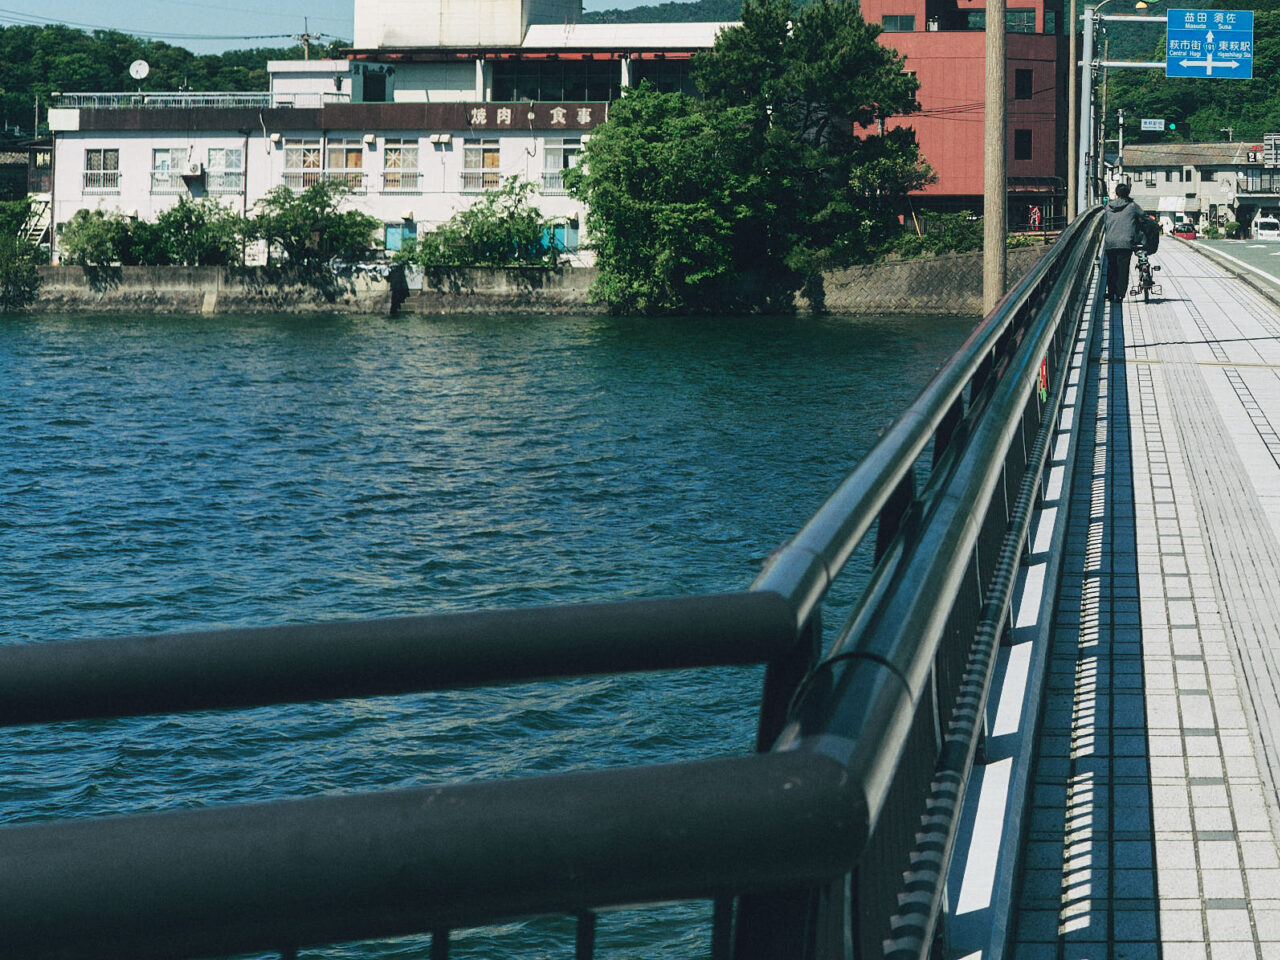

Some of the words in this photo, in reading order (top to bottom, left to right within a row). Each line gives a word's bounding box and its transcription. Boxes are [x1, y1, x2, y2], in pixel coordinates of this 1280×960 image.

[1184, 12, 1207, 22] 益田
[1213, 12, 1236, 24] 須佐
[1169, 40, 1201, 50] 萩市街
[1218, 41, 1250, 52] 東萩駅
